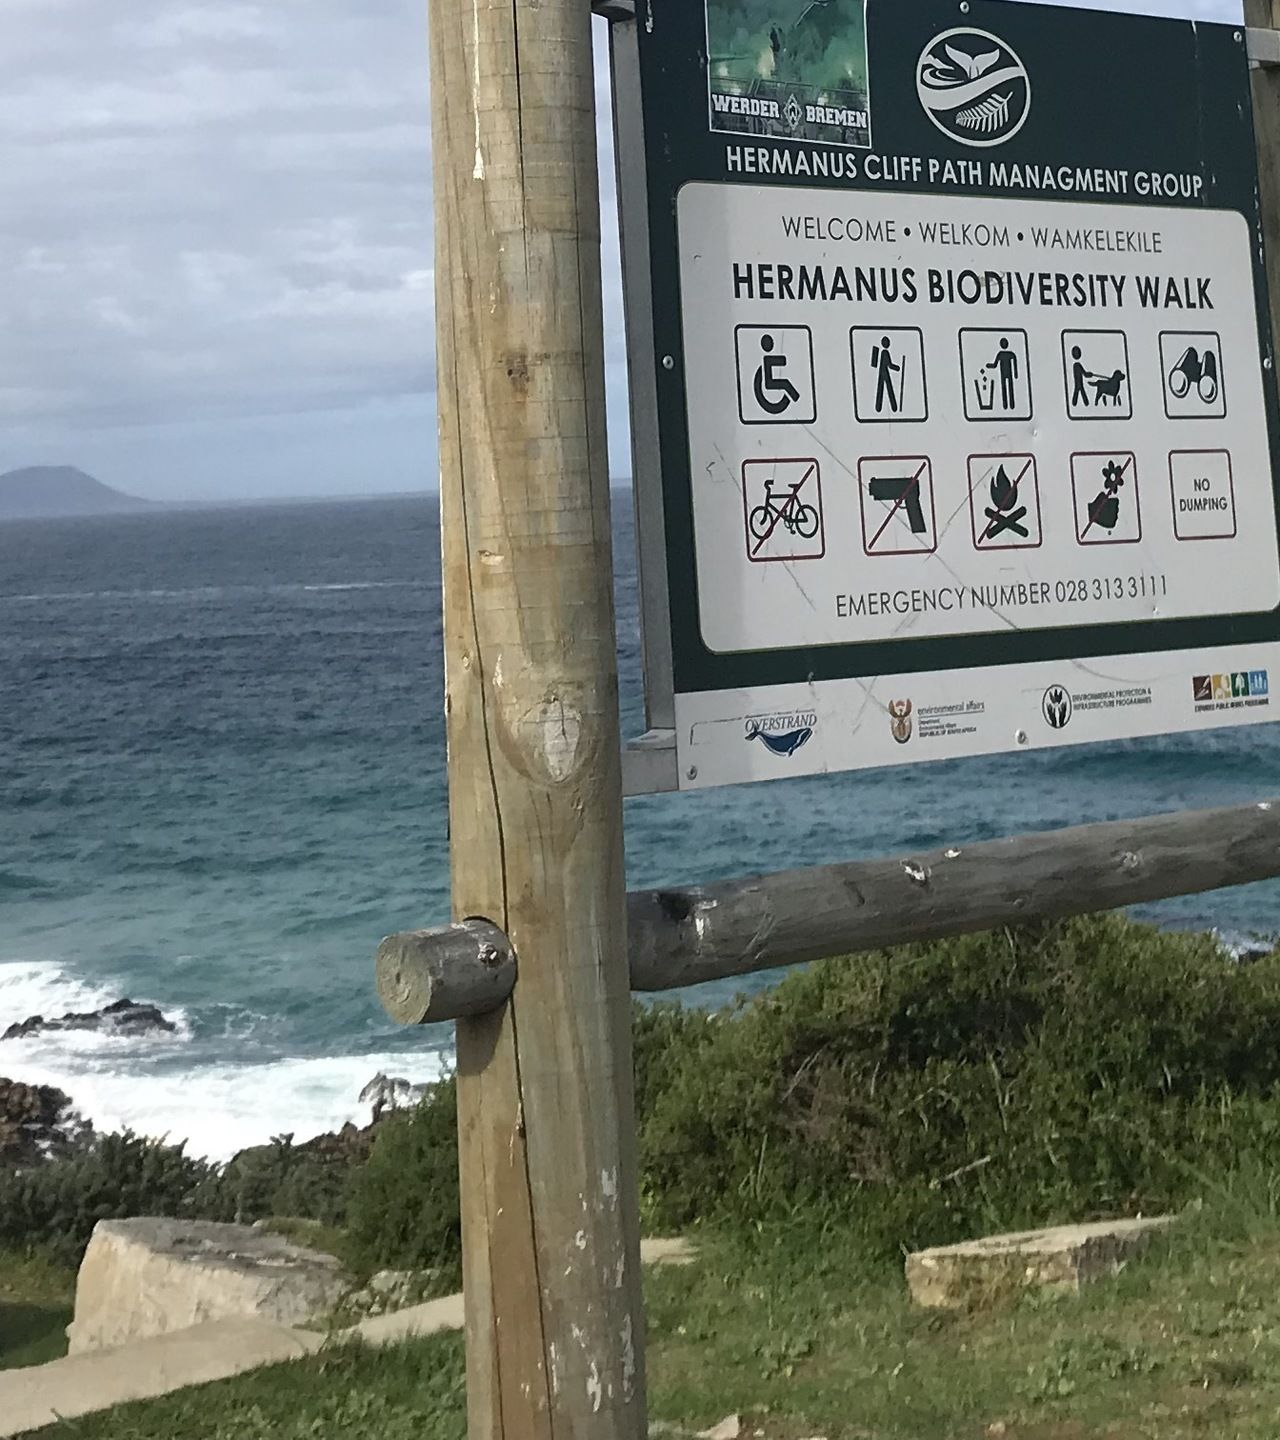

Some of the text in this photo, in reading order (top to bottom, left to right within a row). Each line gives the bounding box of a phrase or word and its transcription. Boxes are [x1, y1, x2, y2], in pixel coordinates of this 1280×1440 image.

[711, 93, 779, 119] WERDER
[805, 105, 867, 129] BREMEN
[726, 145, 1203, 198] HERMANUS CLIFF PATH MANAGMENT GROUP
[782, 215, 1163, 253] WELCOME WELKOM WAMKELEKILE
[733, 263, 1214, 310] HERMANUS BIODIVERSITY WALK
[1193, 478, 1210, 492] NO
[1179, 497, 1228, 512] DUMPING
[836, 574, 1167, 617] EMERGENCY NUMBER 028 313 3111
[745, 714, 818, 733] OVERSTRAND
